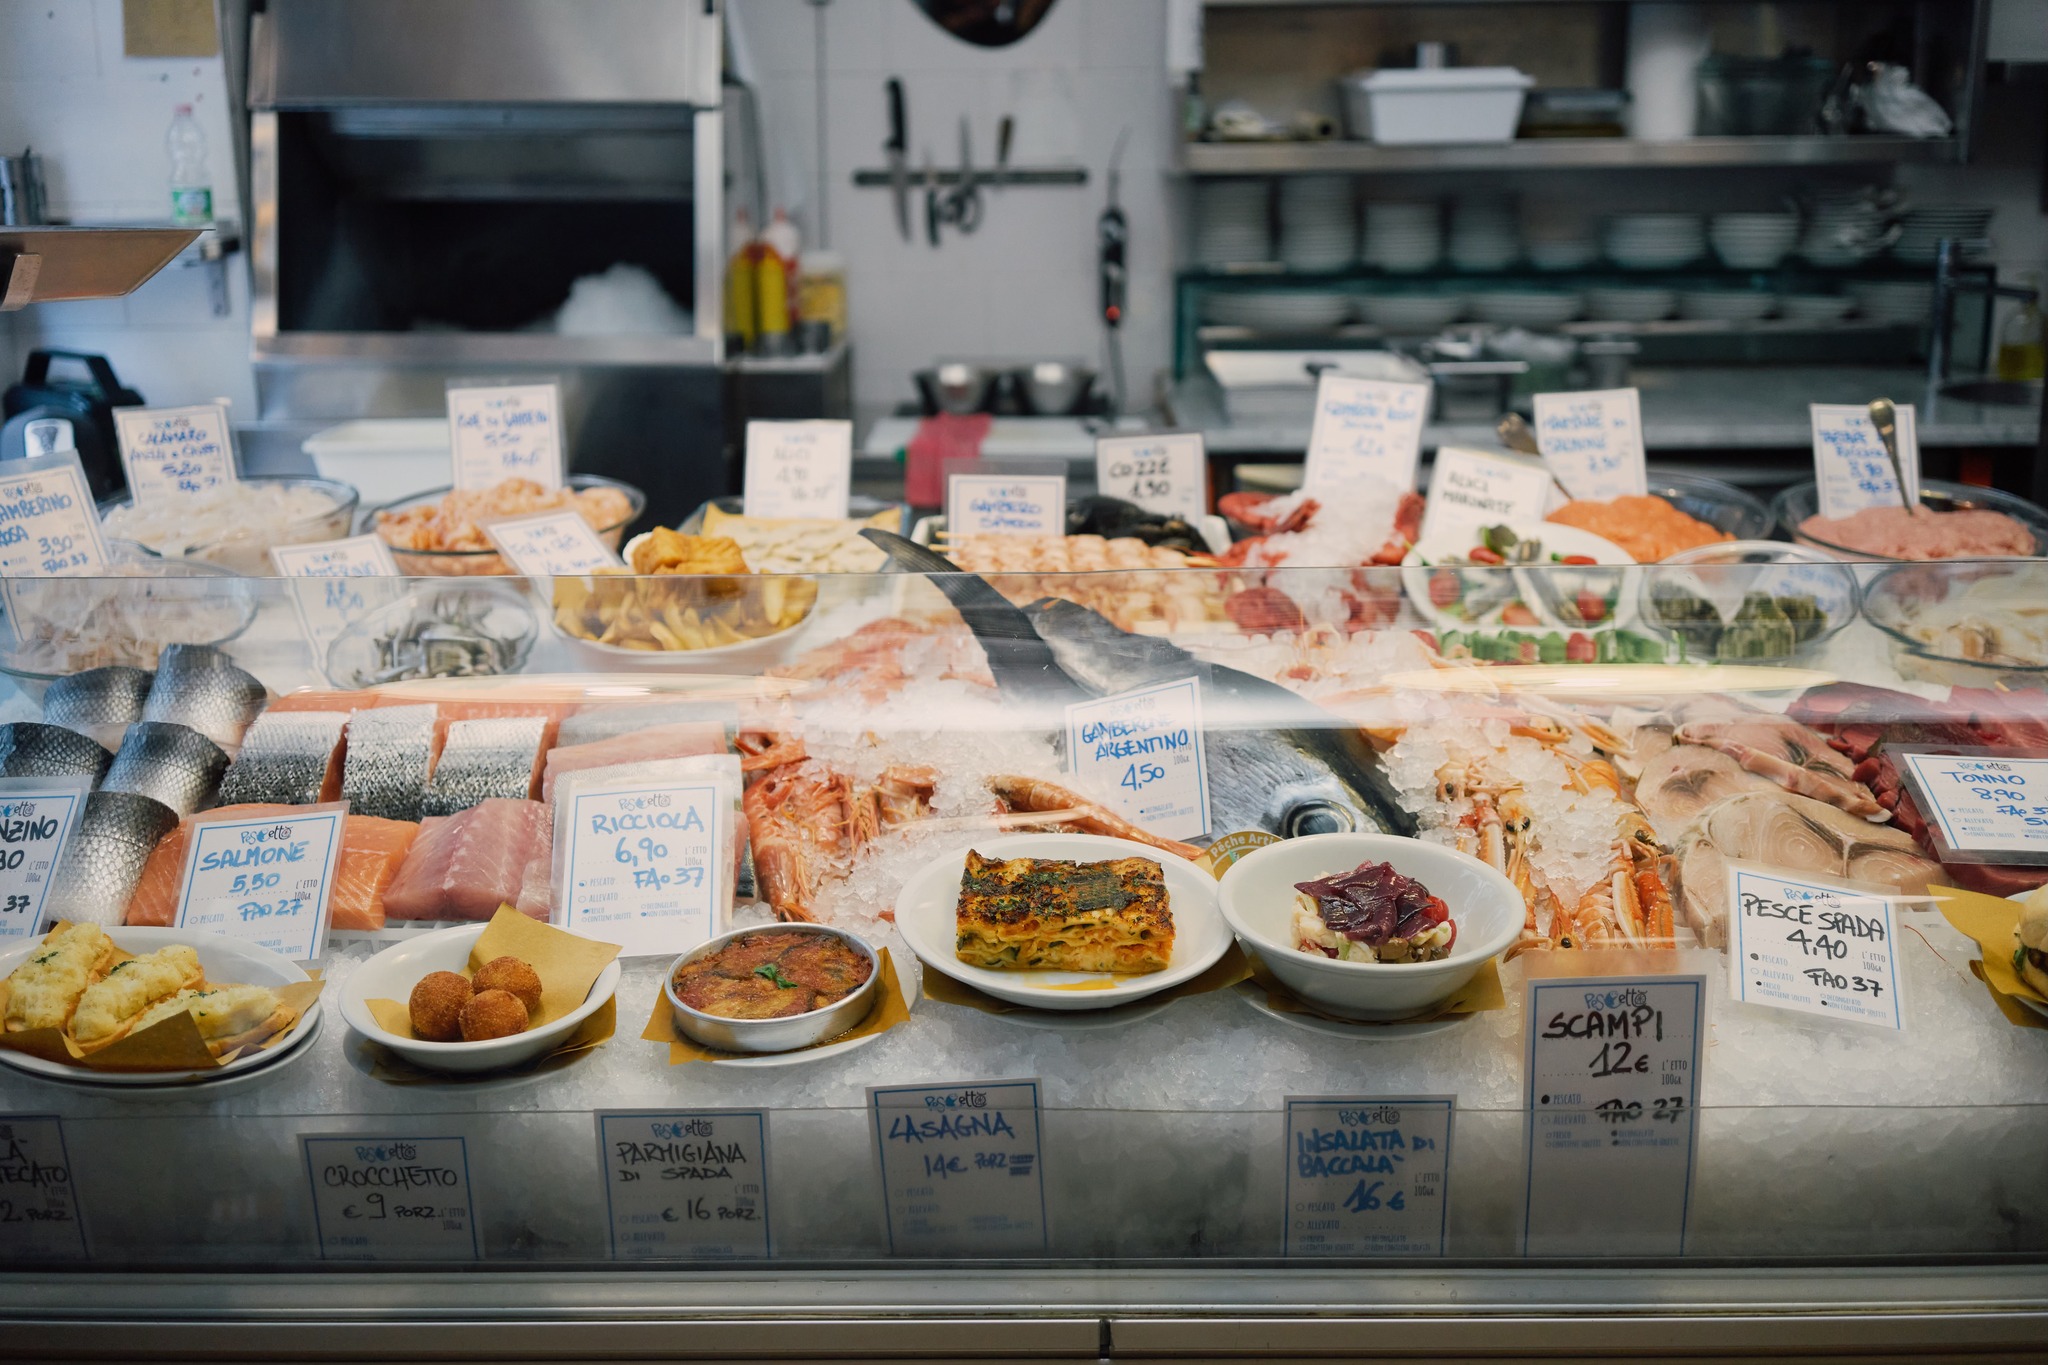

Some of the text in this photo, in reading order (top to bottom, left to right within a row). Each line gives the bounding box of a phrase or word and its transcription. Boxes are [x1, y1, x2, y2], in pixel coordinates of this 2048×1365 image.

[1109, 457, 1170, 478] COZZE
[38, 536, 73, 556] 3,90
[1096, 729, 1189, 761] ARGENTINO
[1941, 772, 2026, 786] TONNO
[591, 805, 705, 835] RICCIOLA
[200, 841, 310, 871] SALMONE
[615, 837, 669, 867] 6,90
[229, 873, 281, 896] 5,50
[590, 877, 615, 887] PESCATO
[673, 866, 704, 888] 37
[3, 895, 31, 914] 37
[275, 899, 304, 916] 27
[589, 893, 618, 903] ALLEVATO
[200, 914, 225, 924] PESCATO
[1741, 893, 1885, 942] PESCE SPADA
[1762, 954, 1788, 966] PESCATO
[1762, 969, 1794, 982] ALLEVATO
[1803, 968, 1884, 998] FAO 37
[1542, 1006, 1663, 1042] SCAMPI
[1553, 1094, 1582, 1105] PESCATO
[1652, 1096, 1685, 1124] 27
[889, 1112, 1015, 1143] LASAGNA
[1553, 1114, 1587, 1125] ALLEVATO
[1297, 1128, 1435, 1153] INSALATA DI
[616, 1141, 747, 1165] PARMIGIANA
[324, 1165, 457, 1191] CROCCHETTO
[619, 1166, 733, 1182] DI SPADA
[688, 1197, 711, 1220] 16
[1307, 1203, 1335, 1212] PESCATO
[1307, 1219, 1340, 1230] ALLEVATO
